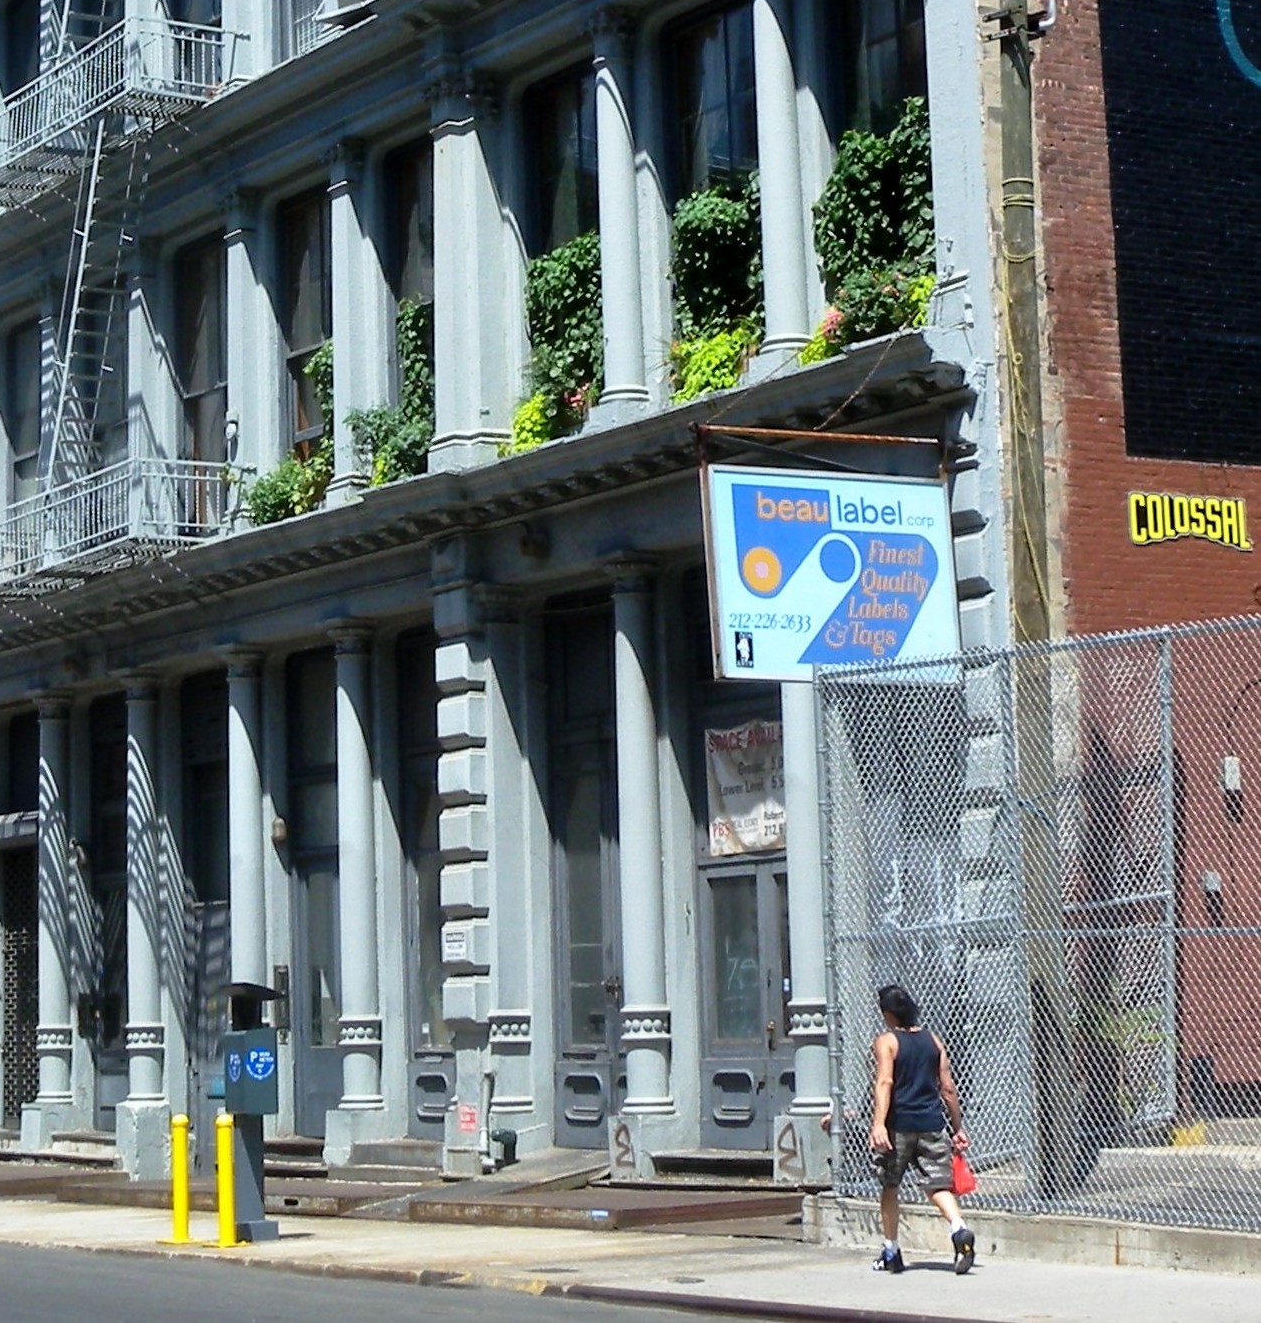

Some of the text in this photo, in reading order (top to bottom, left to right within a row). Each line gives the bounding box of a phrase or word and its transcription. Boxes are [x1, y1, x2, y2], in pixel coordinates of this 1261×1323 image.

[755, 491, 935, 528] beau label corp
[1129, 493, 1251, 549] COLOSSAL
[868, 539, 926, 566] Finest
[861, 568, 929, 601] Quality
[848, 596, 909, 620] Labels
[849, 621, 897, 656] Tags
